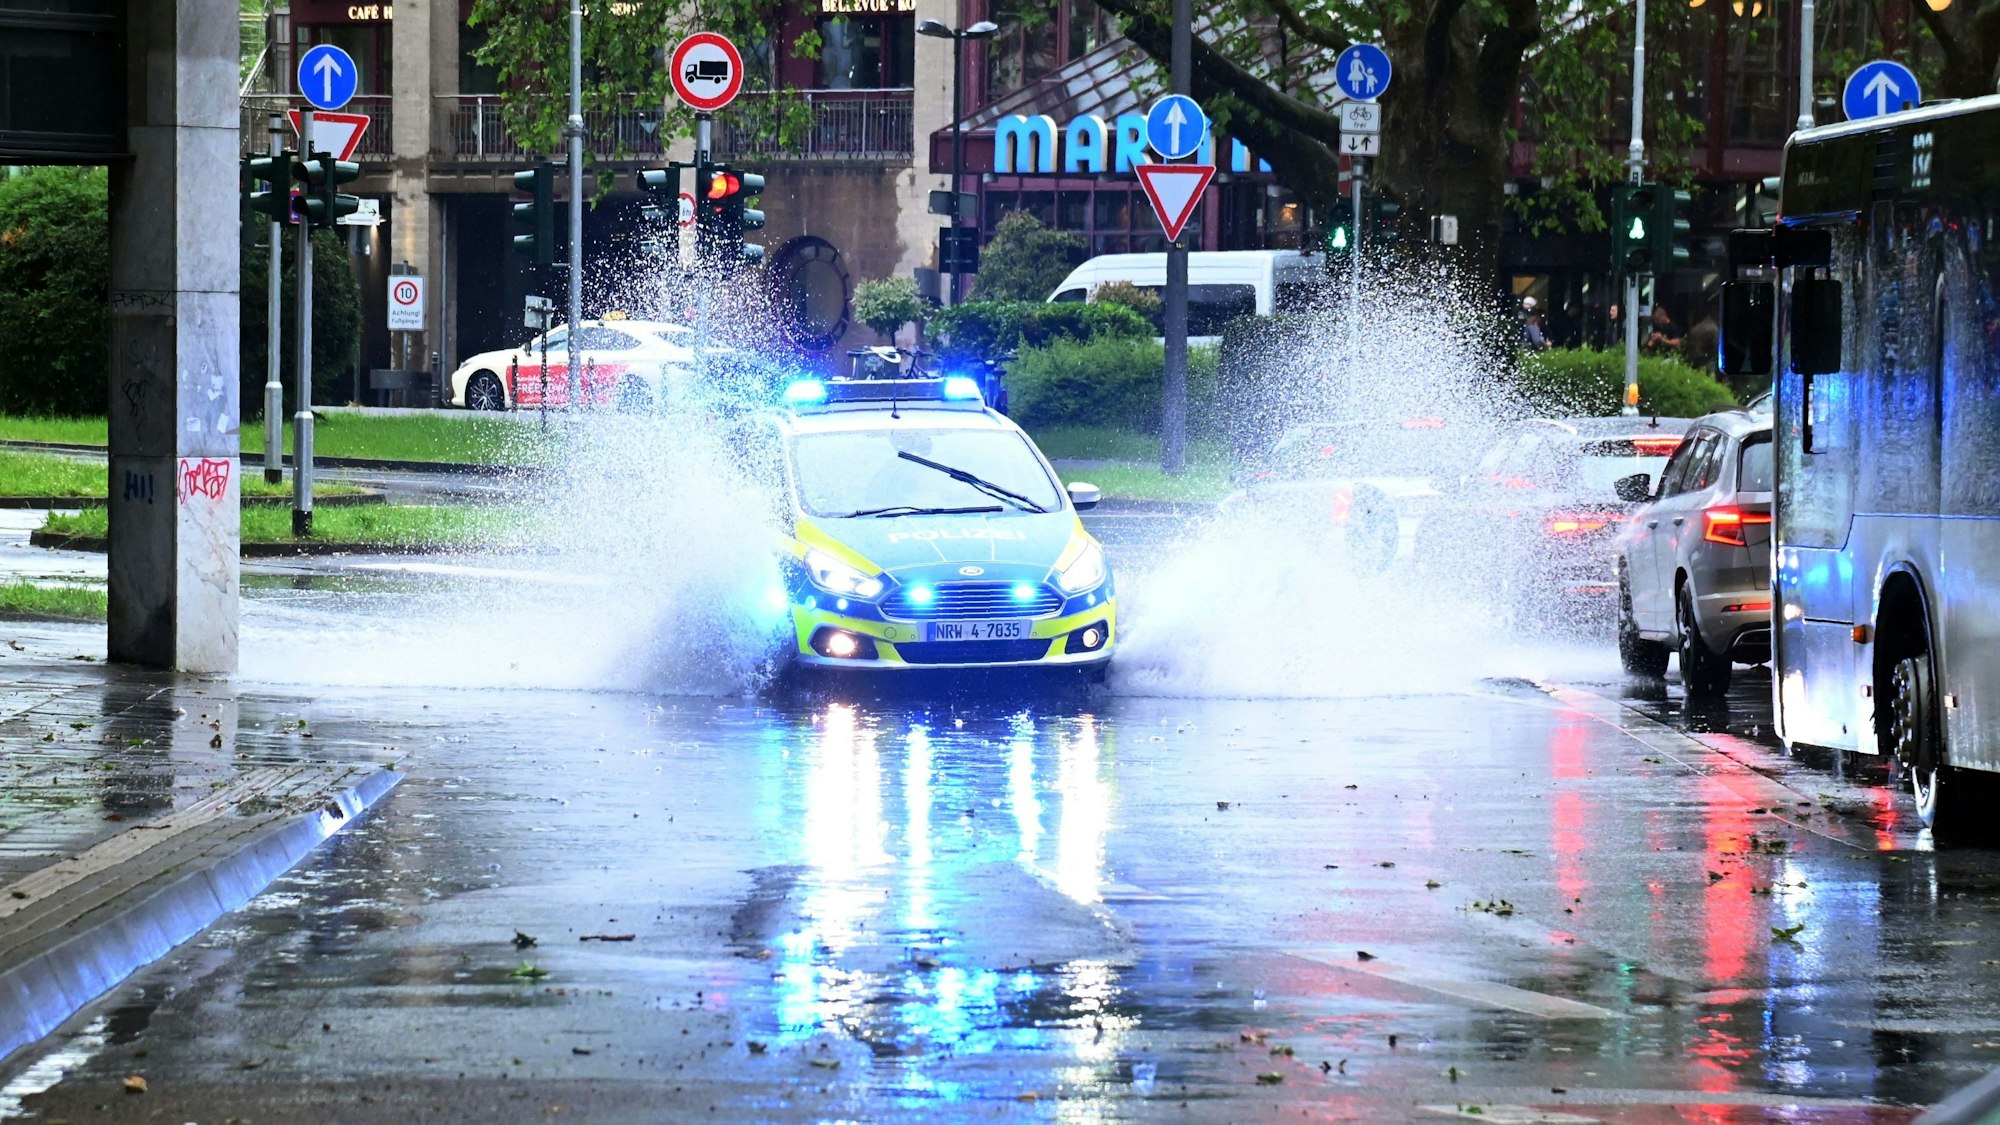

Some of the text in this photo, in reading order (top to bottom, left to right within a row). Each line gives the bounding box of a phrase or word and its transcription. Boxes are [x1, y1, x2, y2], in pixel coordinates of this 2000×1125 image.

[348, 4, 379, 20] CAFÉ
[400, 287, 412, 299] 10
[123, 470, 154, 505] HI!
[887, 528, 1027, 544] POLIZEI
[936, 623, 963, 640] NRW
